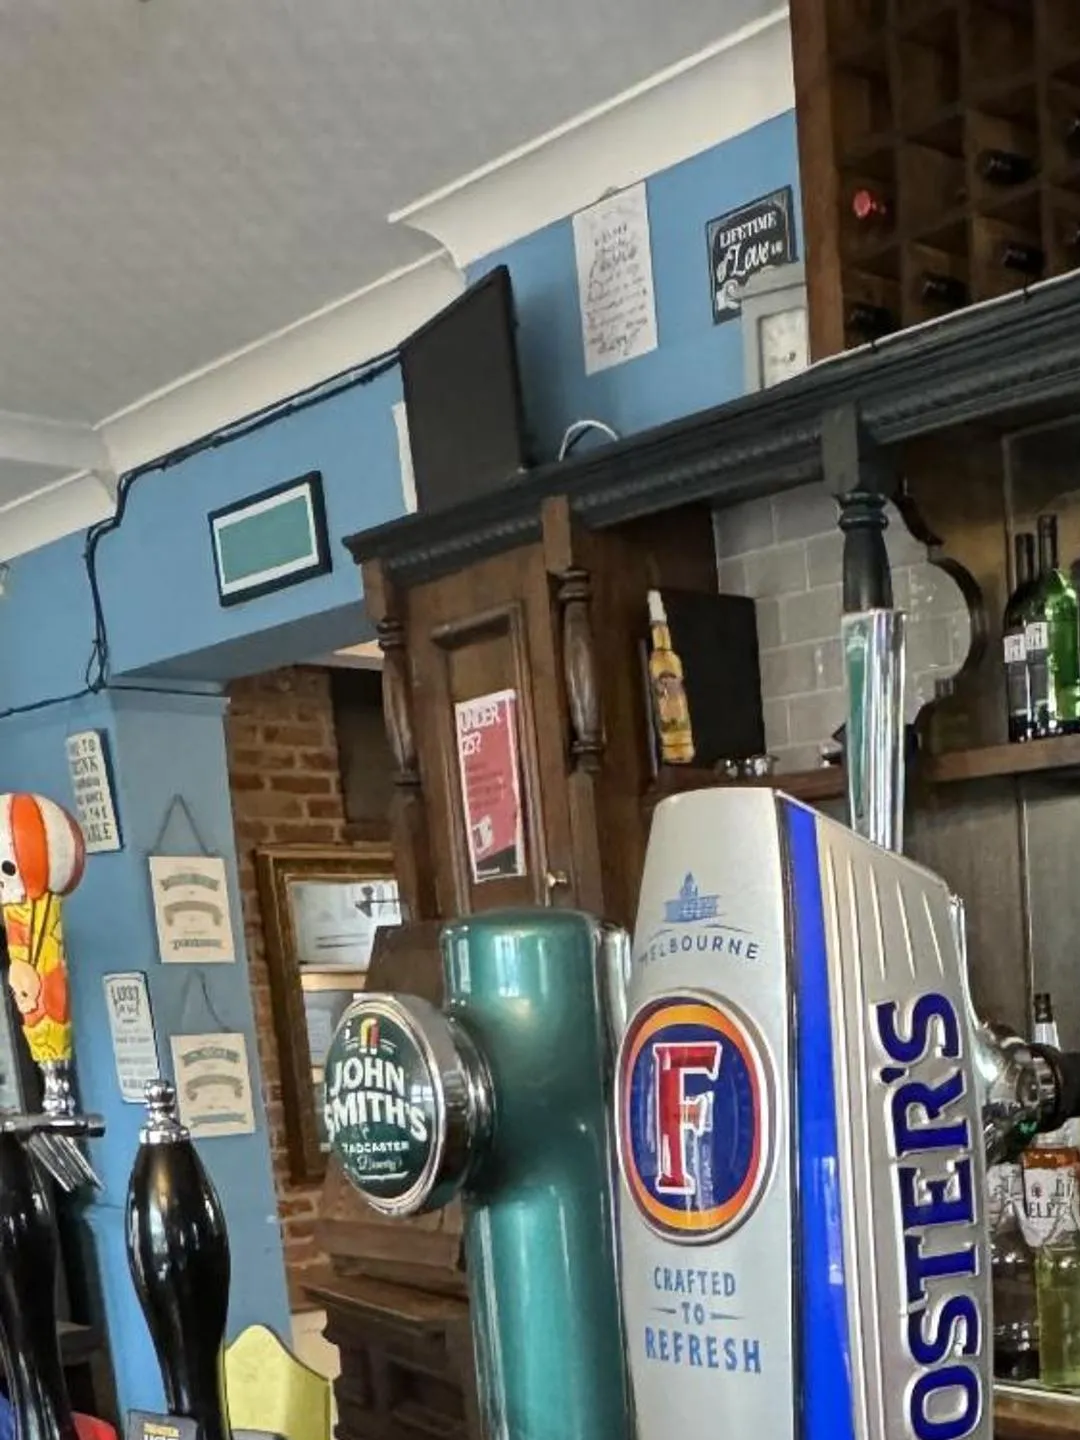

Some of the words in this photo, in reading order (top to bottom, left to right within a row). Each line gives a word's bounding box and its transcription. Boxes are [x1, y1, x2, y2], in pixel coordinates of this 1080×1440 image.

[719, 211, 777, 248] LIFETIME
[730, 241, 769, 276] Love
[459, 703, 501, 731] UNDER
[637, 934, 760, 966] MELBOURNE
[329, 1057, 405, 1097] JOHN
[324, 1090, 427, 1143] SMITH'S
[653, 1041, 722, 1193] F
[341, 1141, 409, 1153] TADCASTER
[654, 1266, 736, 1297] CRAFTED
[681, 1302, 705, 1325] TO
[645, 1326, 762, 1374] REFRESH
